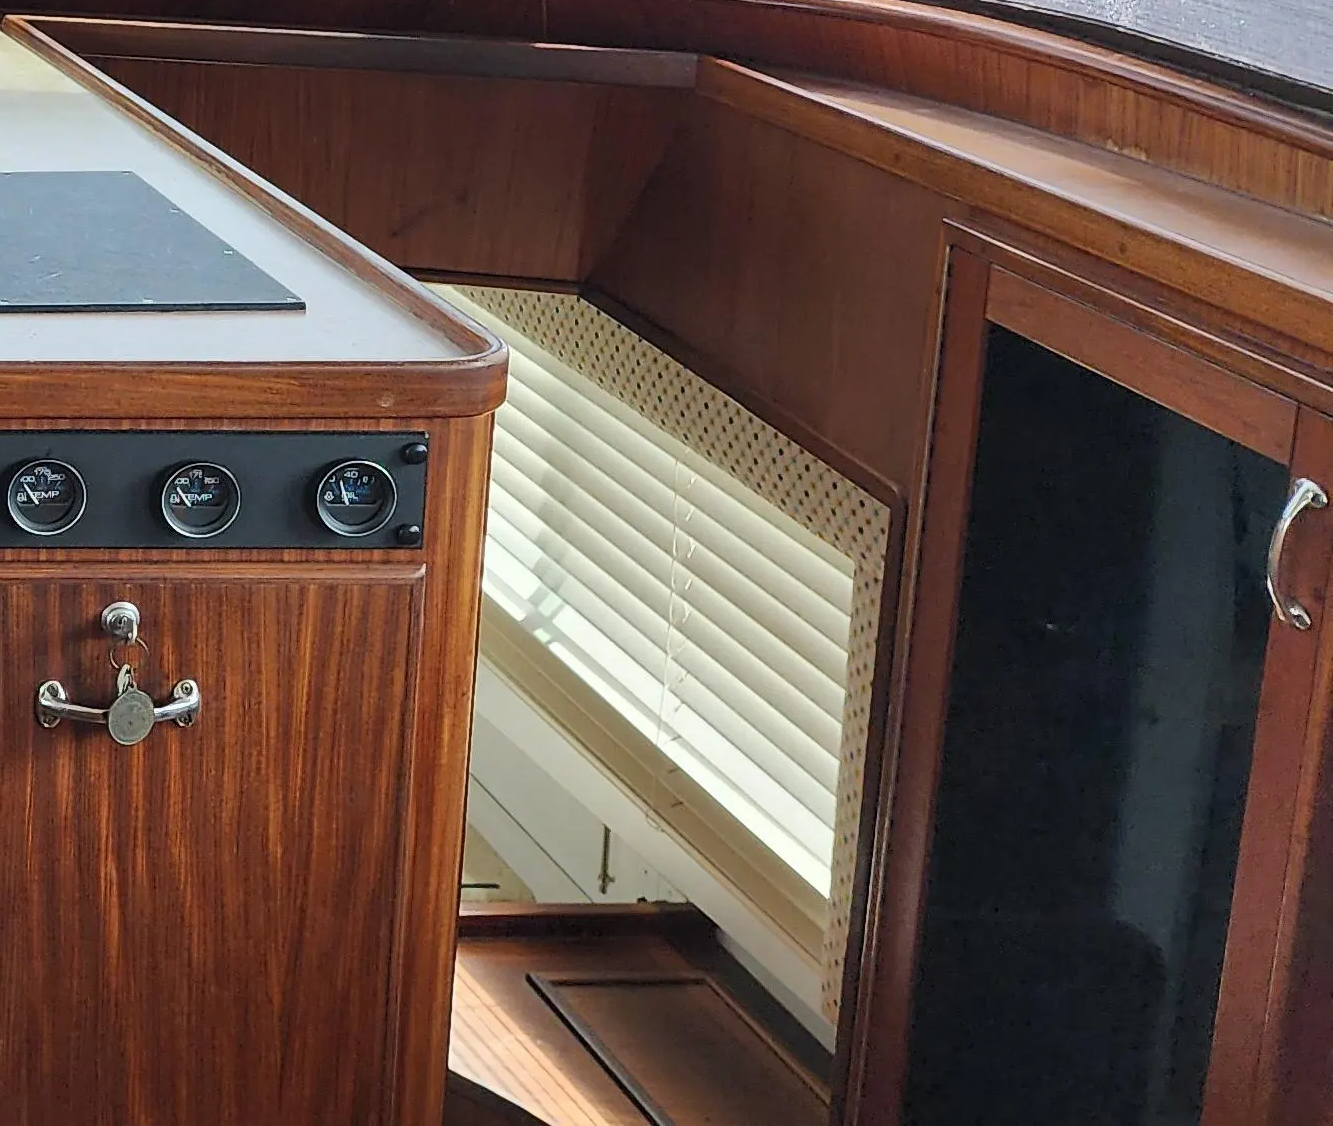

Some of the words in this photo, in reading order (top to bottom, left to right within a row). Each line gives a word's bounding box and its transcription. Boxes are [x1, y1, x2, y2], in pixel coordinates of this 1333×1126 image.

[343, 470, 359, 478] 40
[33, 490, 60, 499] TEMP
[183, 494, 213, 502] TEMP
